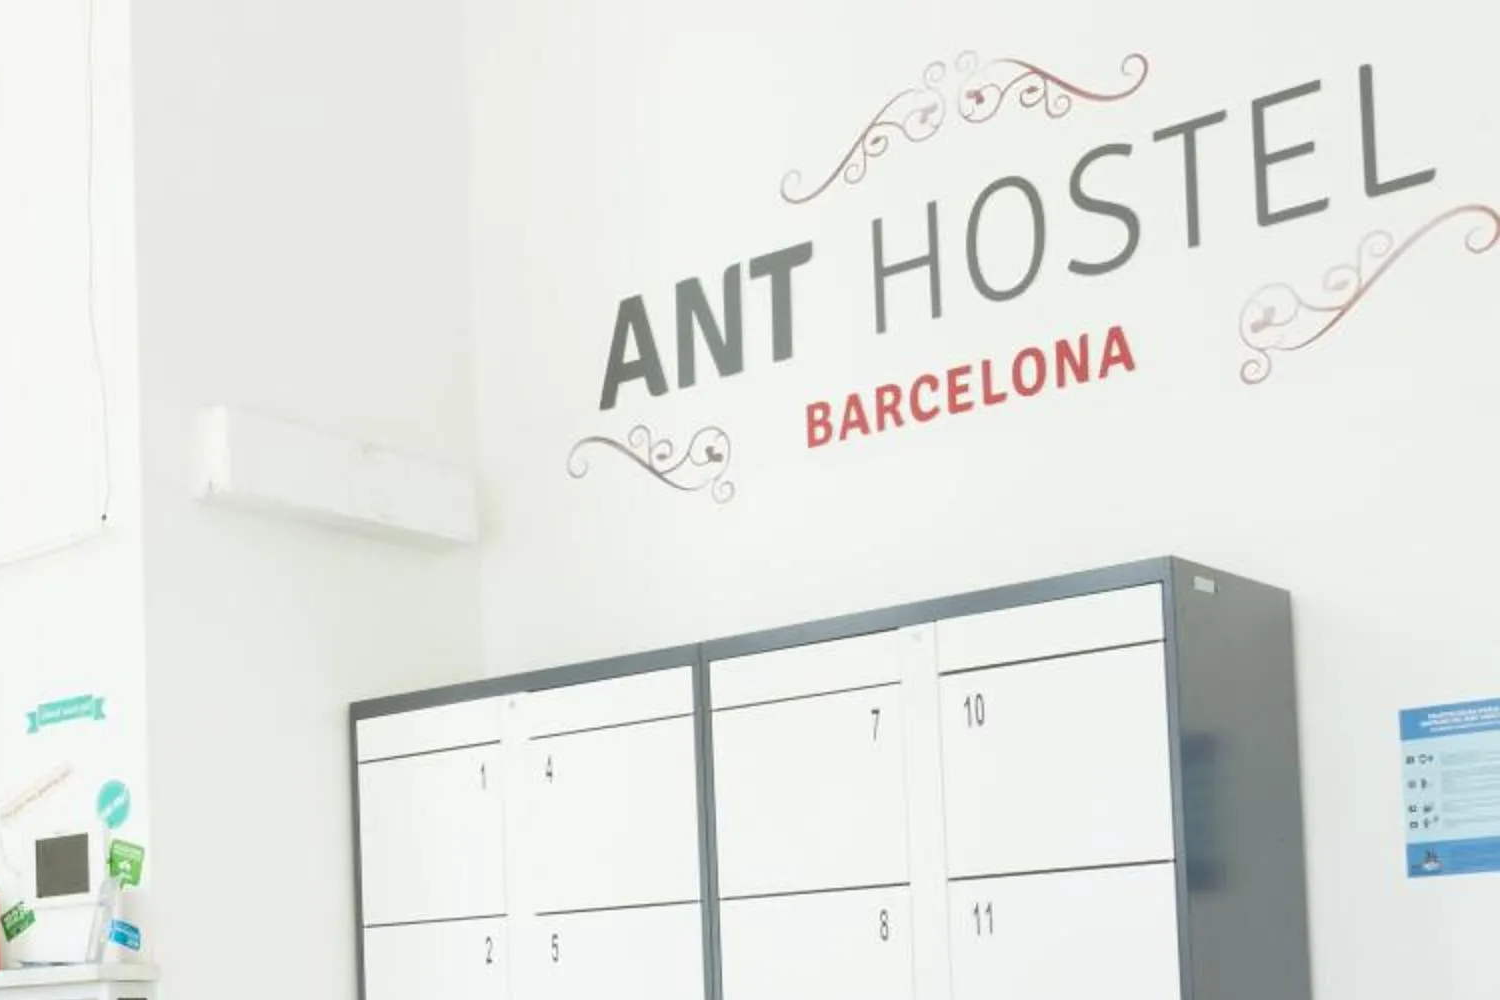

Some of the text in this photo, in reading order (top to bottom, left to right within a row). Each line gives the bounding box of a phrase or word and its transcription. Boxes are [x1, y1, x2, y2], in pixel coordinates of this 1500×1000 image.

[598, 63, 1438, 412] ANT HOSTEL
[805, 325, 1137, 449] BARCELONA
[870, 707, 881, 742] 7
[963, 692, 986, 729] 10
[480, 762, 487, 790] 1
[545, 755, 554, 784] 4
[879, 908, 890, 943] 8
[972, 901, 994, 937] 11
[485, 935, 494, 966] 2
[551, 932, 560, 964] 5
